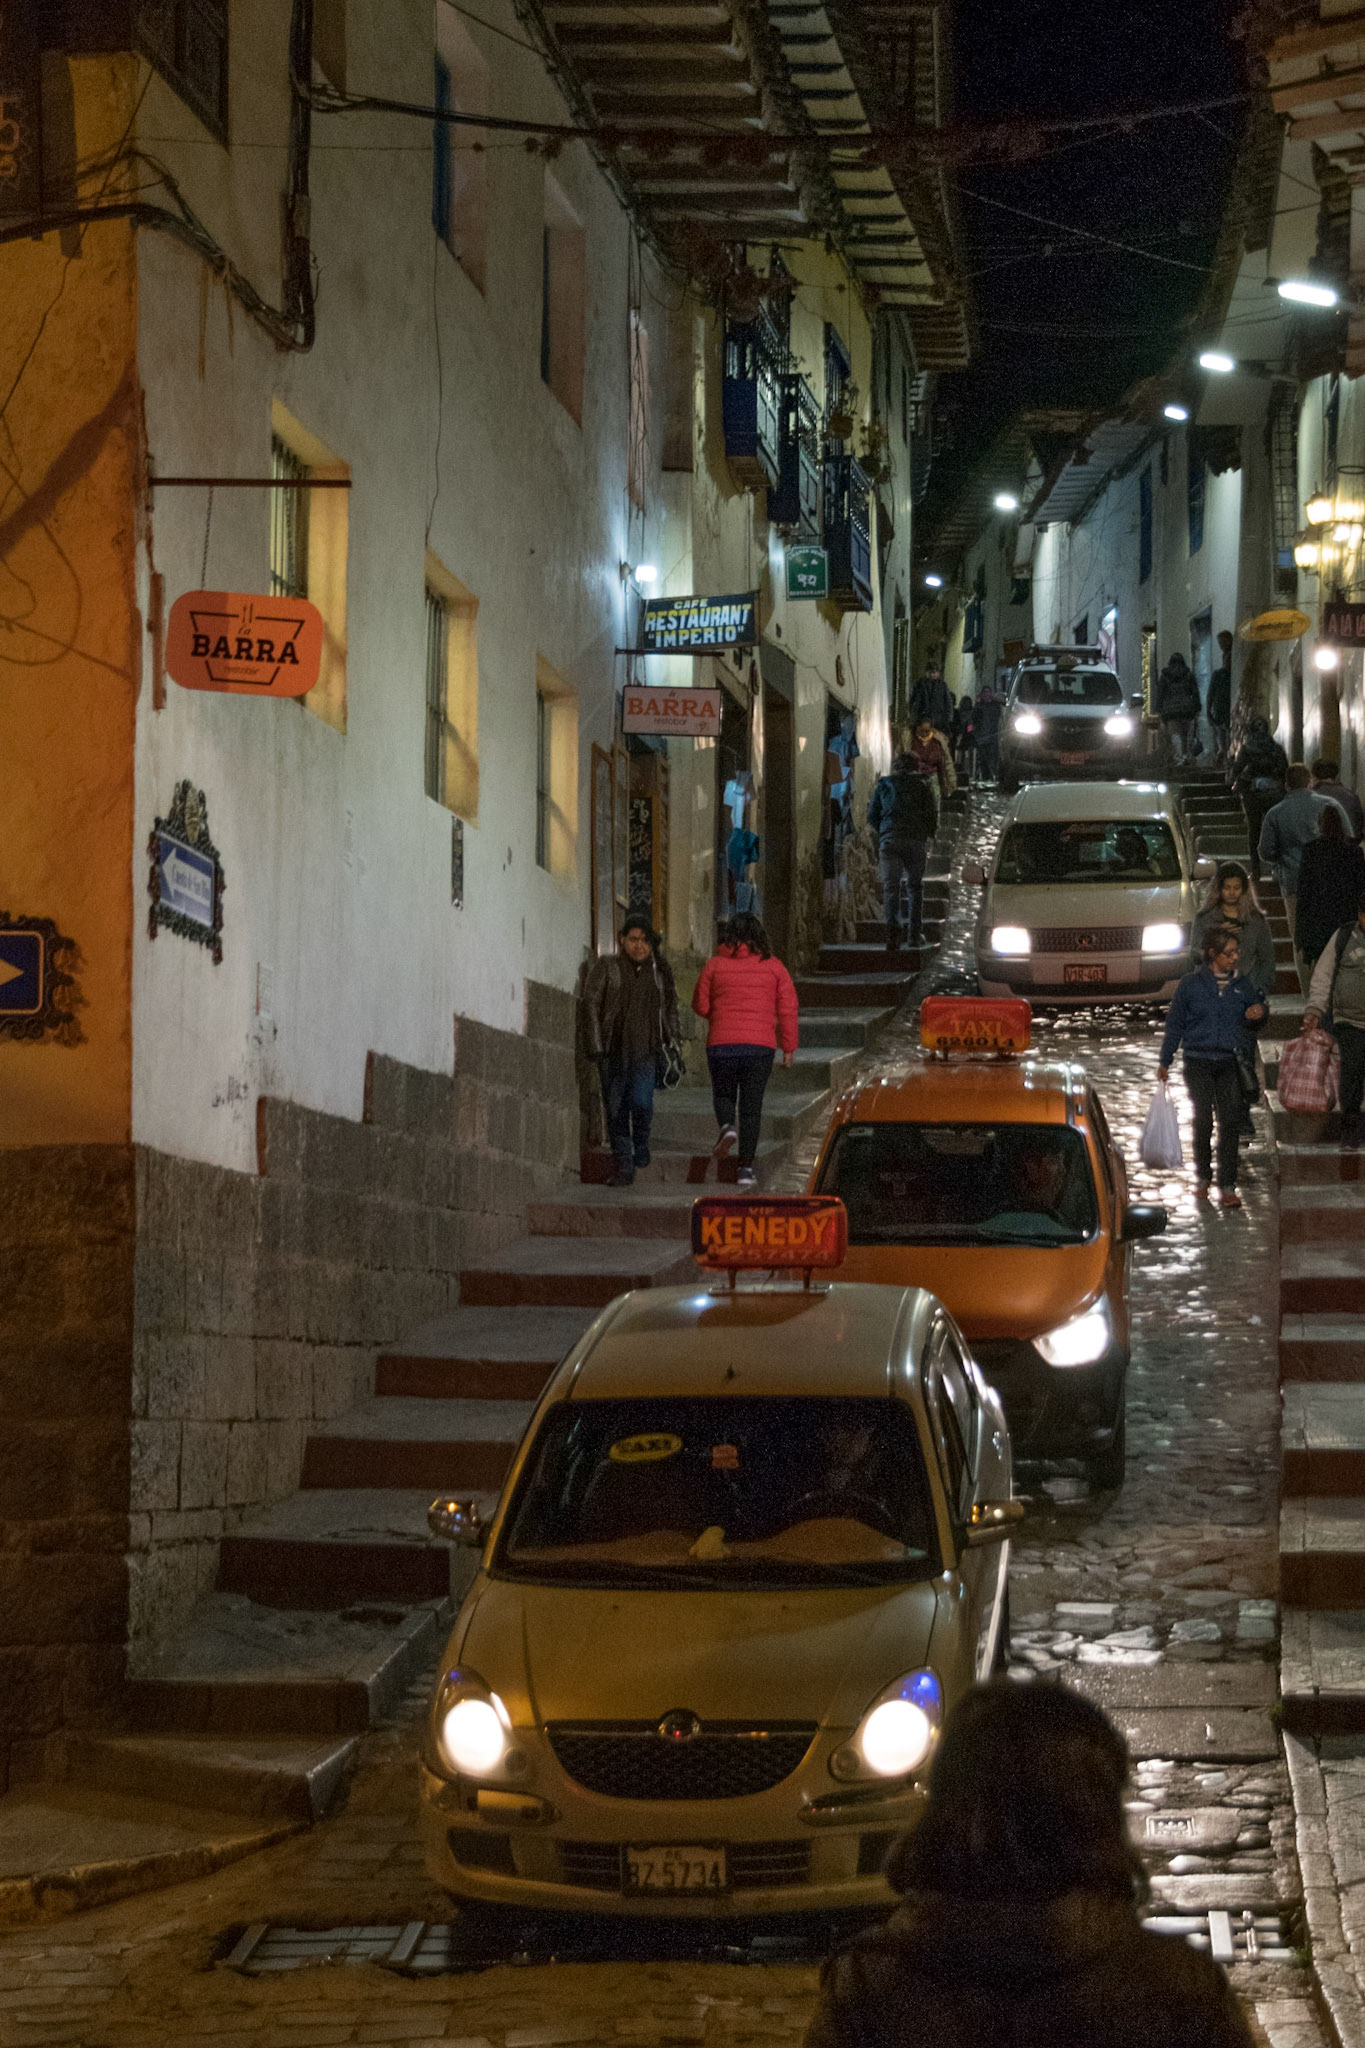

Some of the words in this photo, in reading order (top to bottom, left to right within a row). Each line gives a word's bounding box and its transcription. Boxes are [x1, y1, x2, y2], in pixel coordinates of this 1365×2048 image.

[674, 598, 709, 610] CAFE
[644, 603, 752, 633] RESTAURANT
[191, 633, 300, 665] BARRA
[627, 697, 716, 718] BARRA
[653, 717, 688, 726] restobar
[950, 1019, 1002, 1036] TAXI
[700, 1216, 828, 1246] KENEDY
